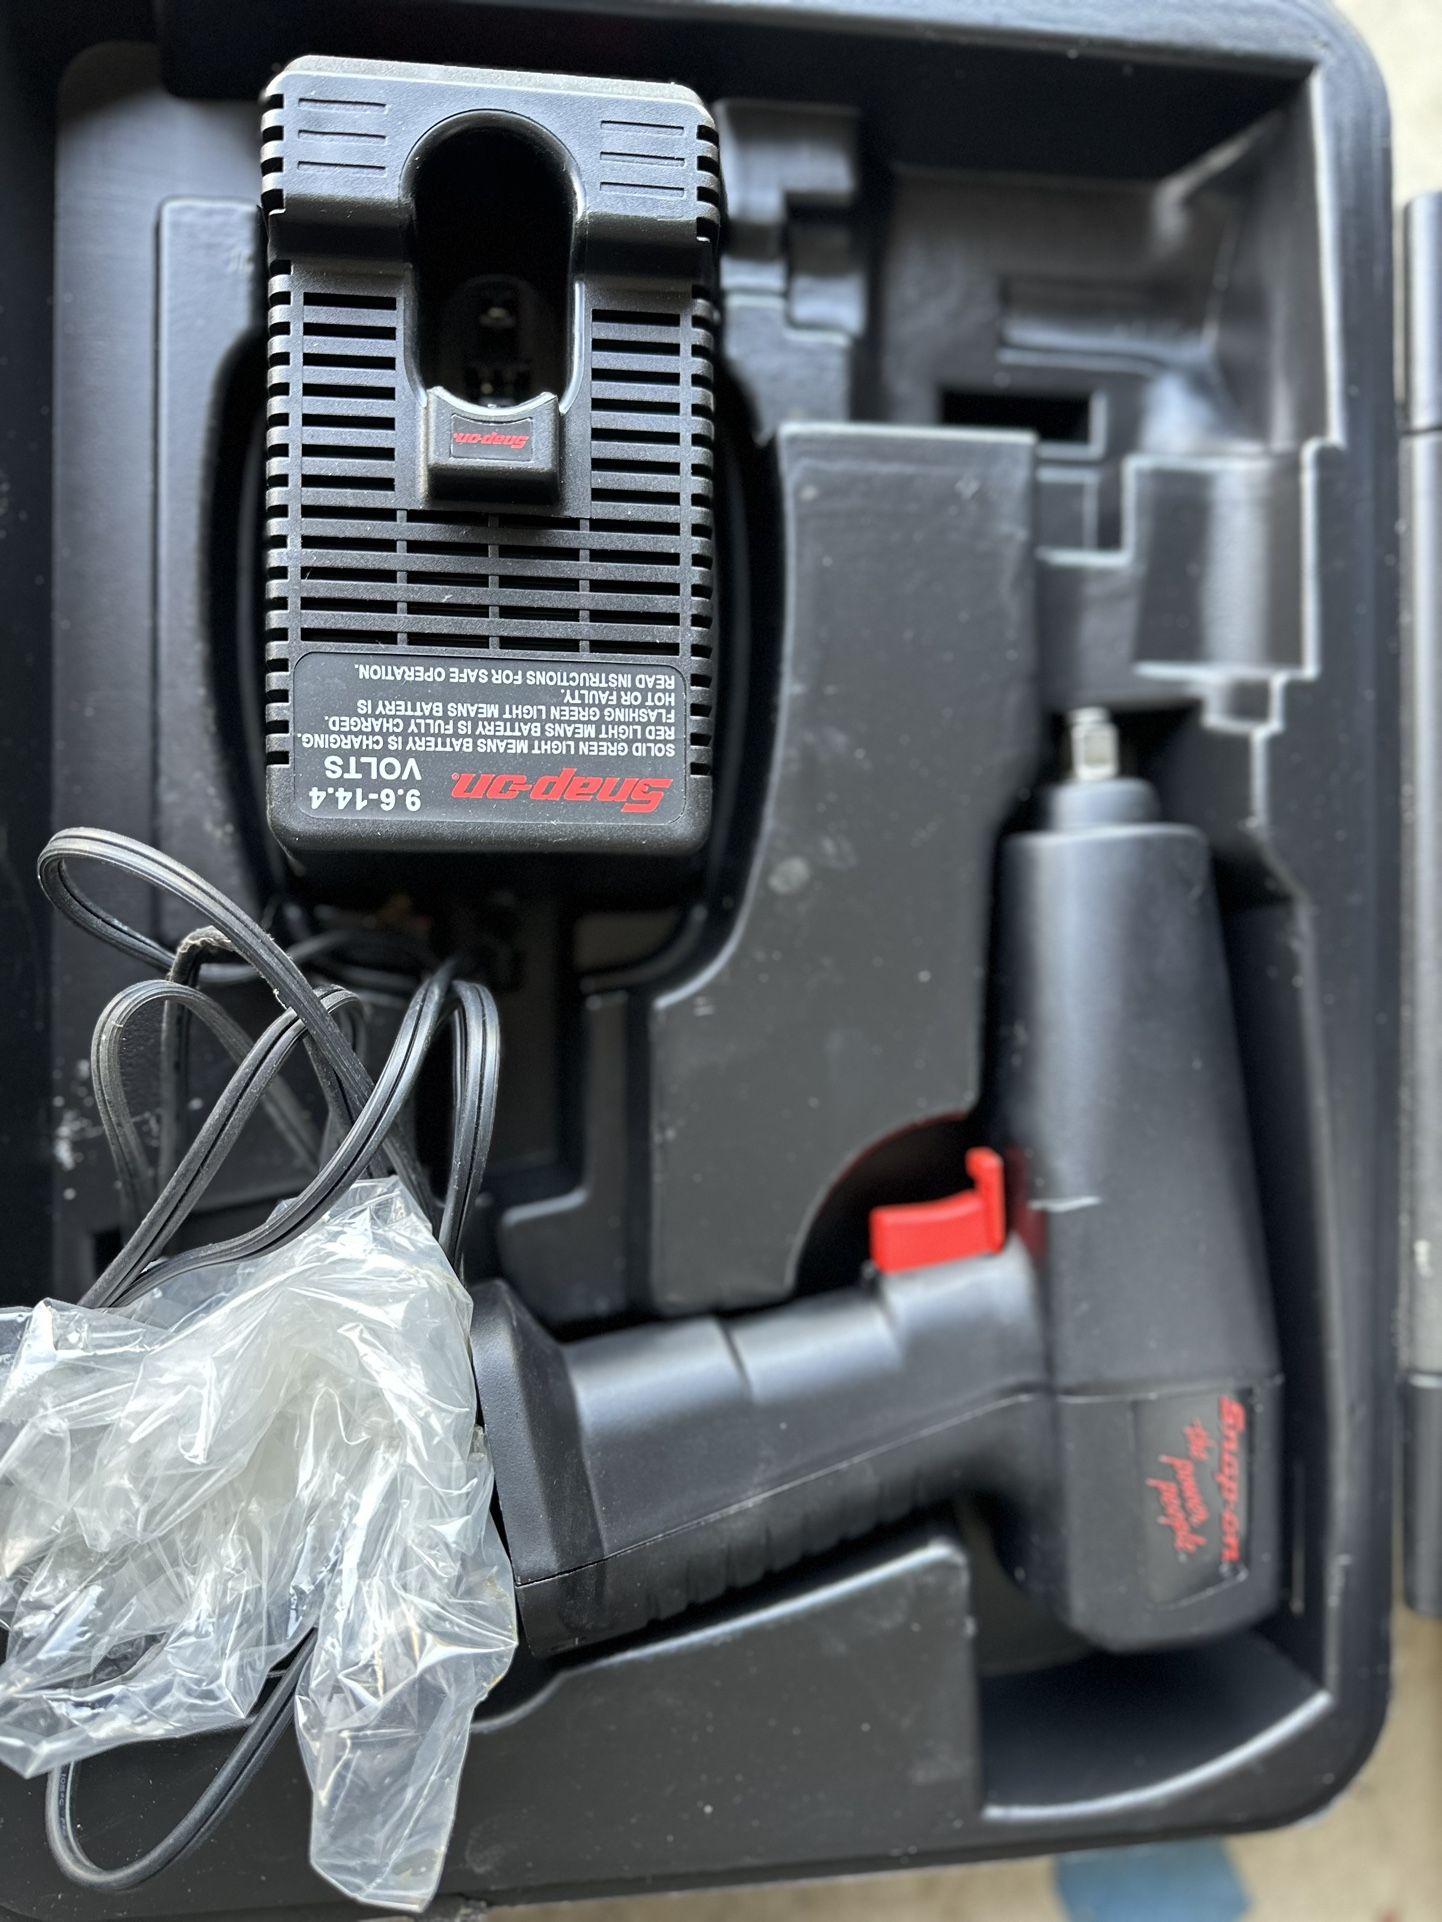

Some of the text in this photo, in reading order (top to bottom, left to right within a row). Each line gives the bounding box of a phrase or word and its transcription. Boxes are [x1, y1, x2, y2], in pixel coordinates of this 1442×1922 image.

[453, 431, 529, 448] Snap-on
[354, 664, 675, 689] READ INSTRUCTIONS FOR SAFE OPERATION.
[560, 689, 675, 706] HOT OR FAULTY.
[356, 699, 675, 723] FLASHING GREEN LIGHT MEANS BATTERY IS
[324, 716, 675, 740] RED LIGHT MEANS BATTERY IS FULLY CHARGED.
[297, 732, 676, 757] SOLID GREEN LIGHT MEANS BATTERY IS CHARGING.
[324, 755, 422, 780] VOLTS
[308, 786, 421, 812] 9.6-14.4
[451, 767, 674, 813] Snap-on
[1214, 1395, 1247, 1562] Snap-on
